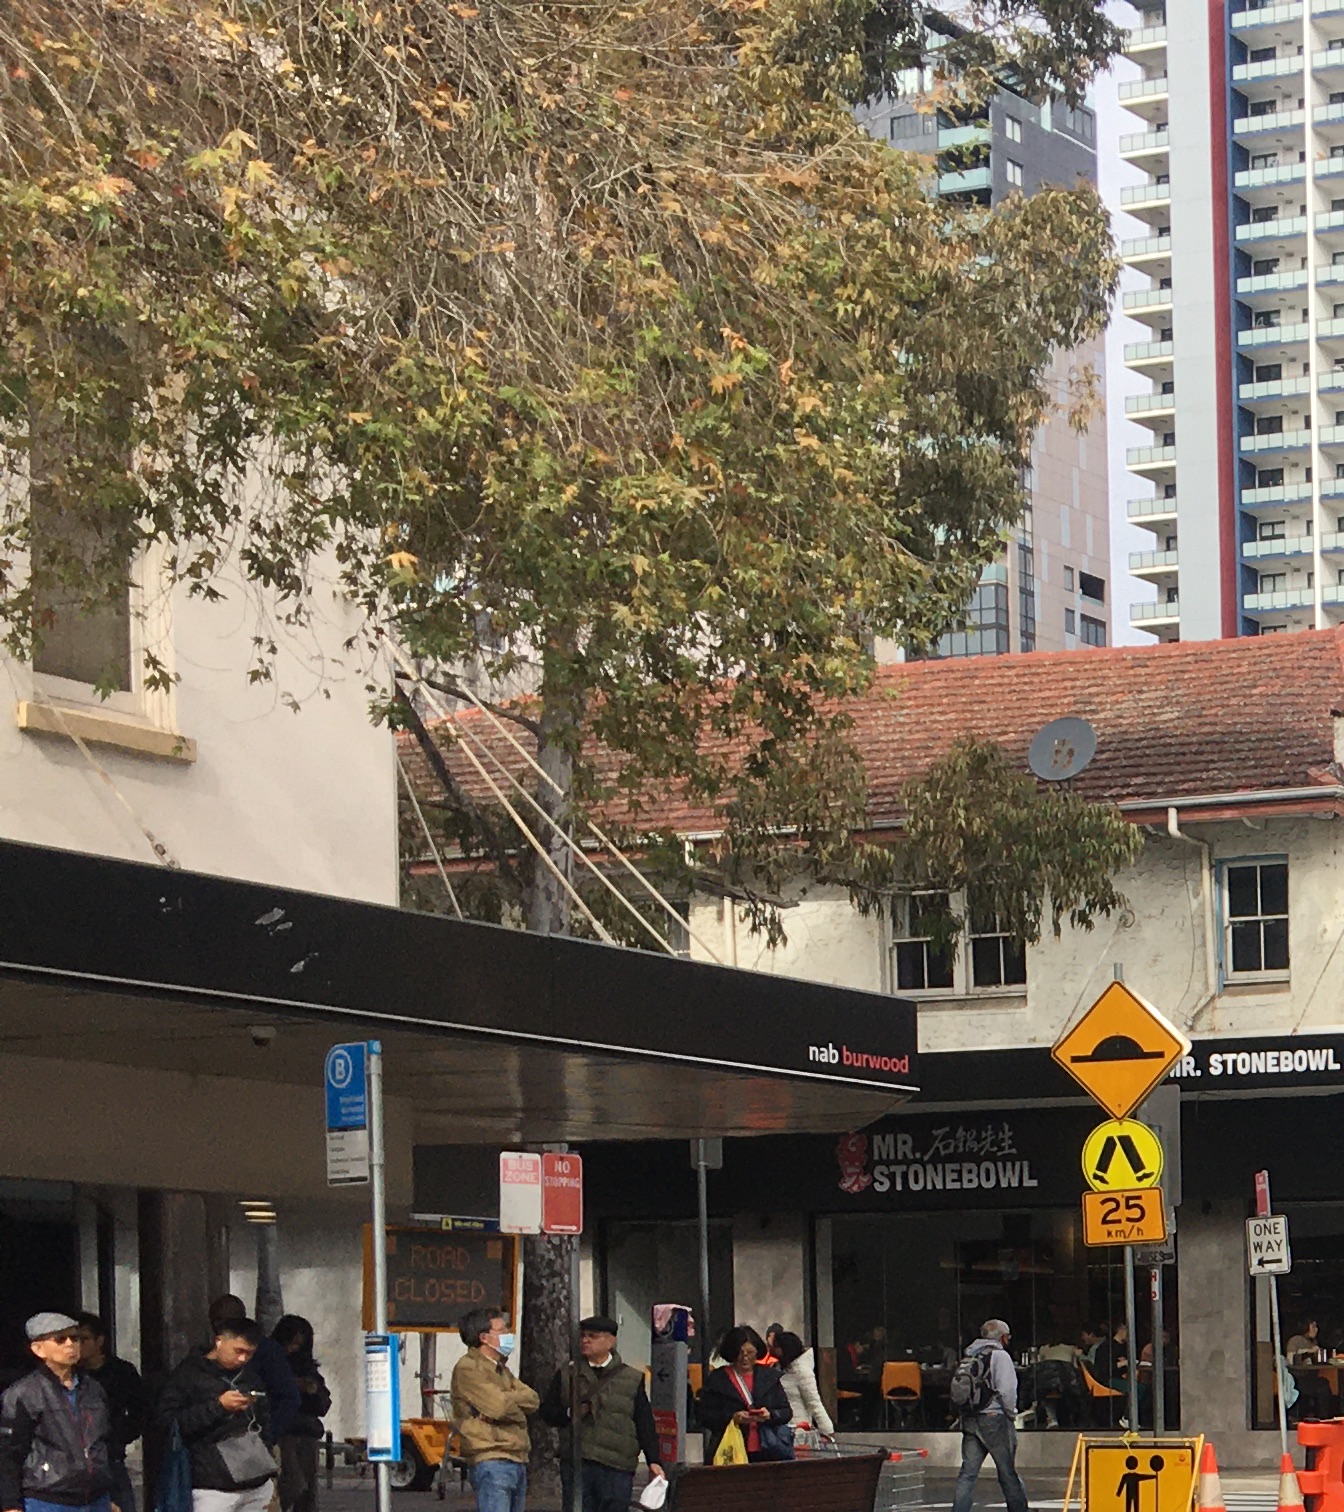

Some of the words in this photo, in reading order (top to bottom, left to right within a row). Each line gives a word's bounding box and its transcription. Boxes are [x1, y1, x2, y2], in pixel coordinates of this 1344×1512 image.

[335, 1058, 346, 1080] B
[808, 1042, 839, 1064] nab
[842, 1045, 910, 1074] burwood
[1208, 1048, 1341, 1077] STONEBOWL
[872, 1133, 921, 1161] MR.
[504, 1171, 538, 1183] ZONE
[508, 1160, 534, 1172] BUS
[554, 1161, 571, 1174] NO
[872, 1160, 1039, 1192] STONEBOWL
[544, 1177, 580, 1189] STOPPING
[1100, 1194, 1147, 1226] 25
[1106, 1224, 1144, 1239] km/h
[1253, 1221, 1281, 1237] ONE
[1253, 1239, 1283, 1254] WAY
[410, 1245, 472, 1271] ROAD
[393, 1277, 486, 1303] CLOSED
